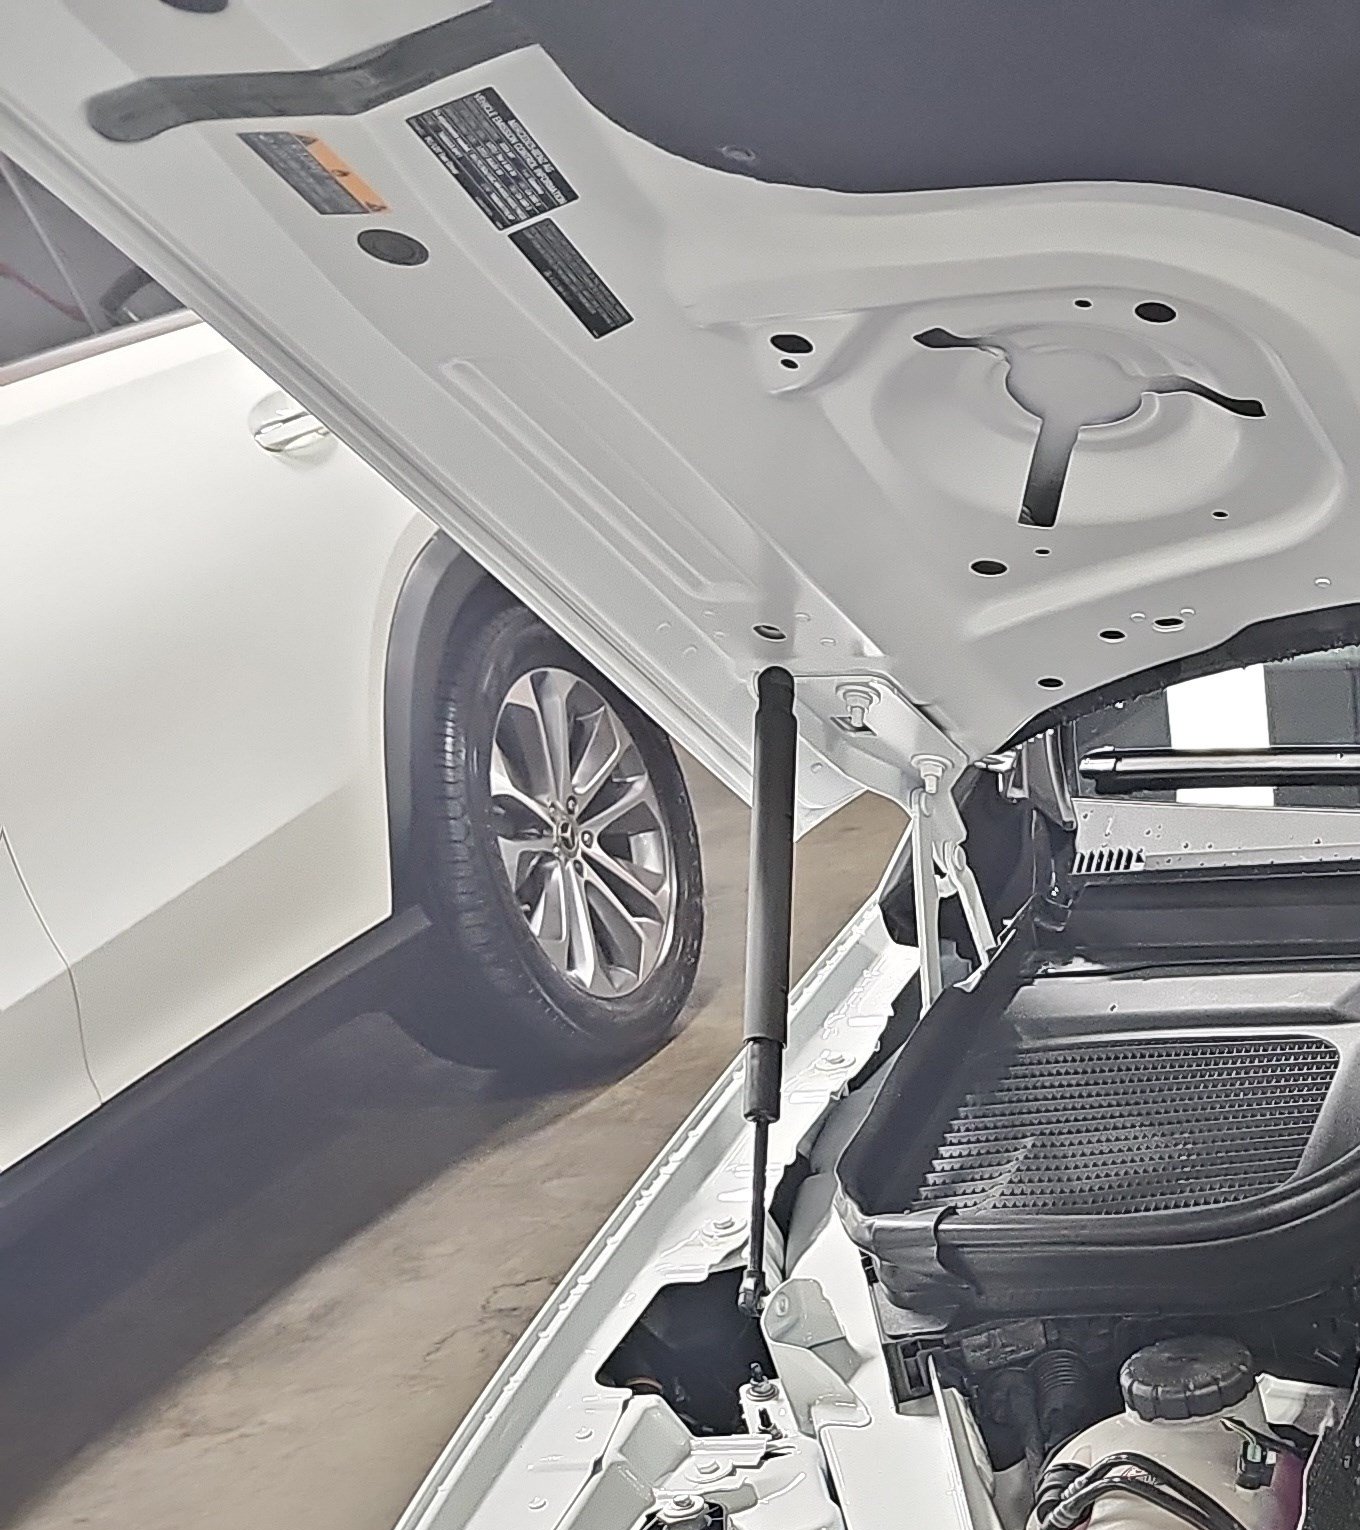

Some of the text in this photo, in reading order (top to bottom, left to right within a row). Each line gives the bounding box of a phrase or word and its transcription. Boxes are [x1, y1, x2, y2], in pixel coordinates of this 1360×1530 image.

[472, 92, 567, 204] VEHICLE EMISSION CONTROL INFORMATION
